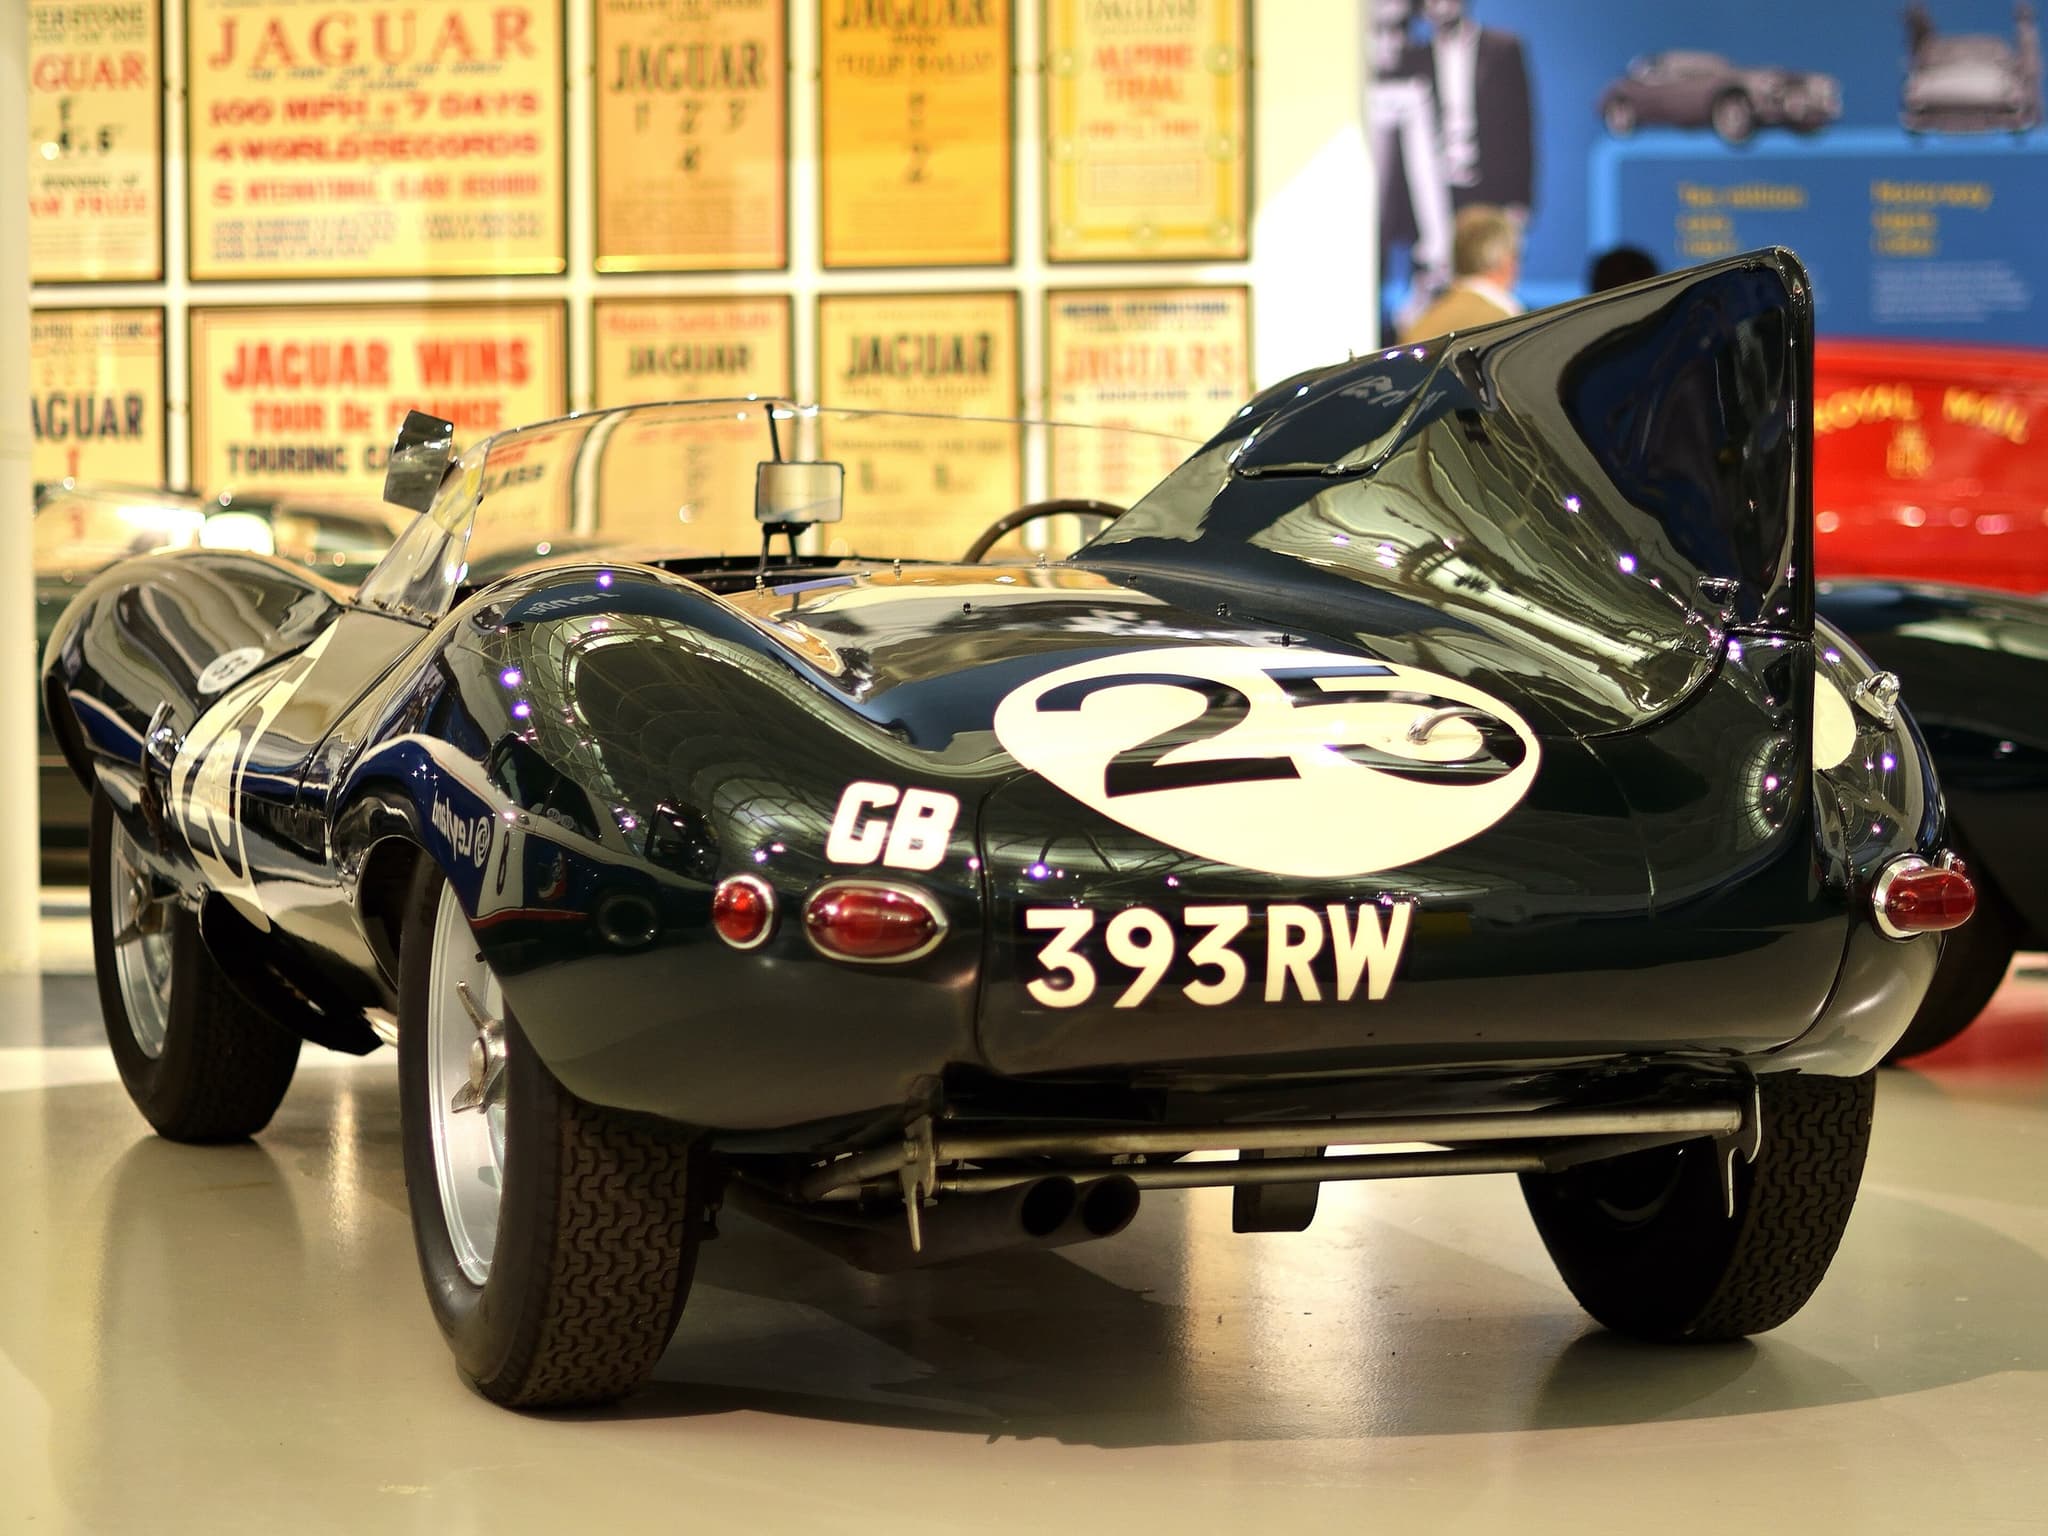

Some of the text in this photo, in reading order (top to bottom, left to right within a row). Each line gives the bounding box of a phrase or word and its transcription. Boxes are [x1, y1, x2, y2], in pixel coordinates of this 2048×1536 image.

[207, 5, 538, 71] JAGUAR
[612, 41, 767, 92] JAGUAR
[208, 97, 273, 126] 100
[439, 91, 540, 119] DAYS
[224, 339, 531, 389] JAGUAR WINS
[843, 331, 993, 382] JAGUAR
[250, 402, 324, 431] TOUR
[226, 444, 348, 475] TOURING
[1036, 665, 1528, 800] 25
[826, 781, 960, 871] GB
[1026, 903, 1414, 1009] 393 RW
